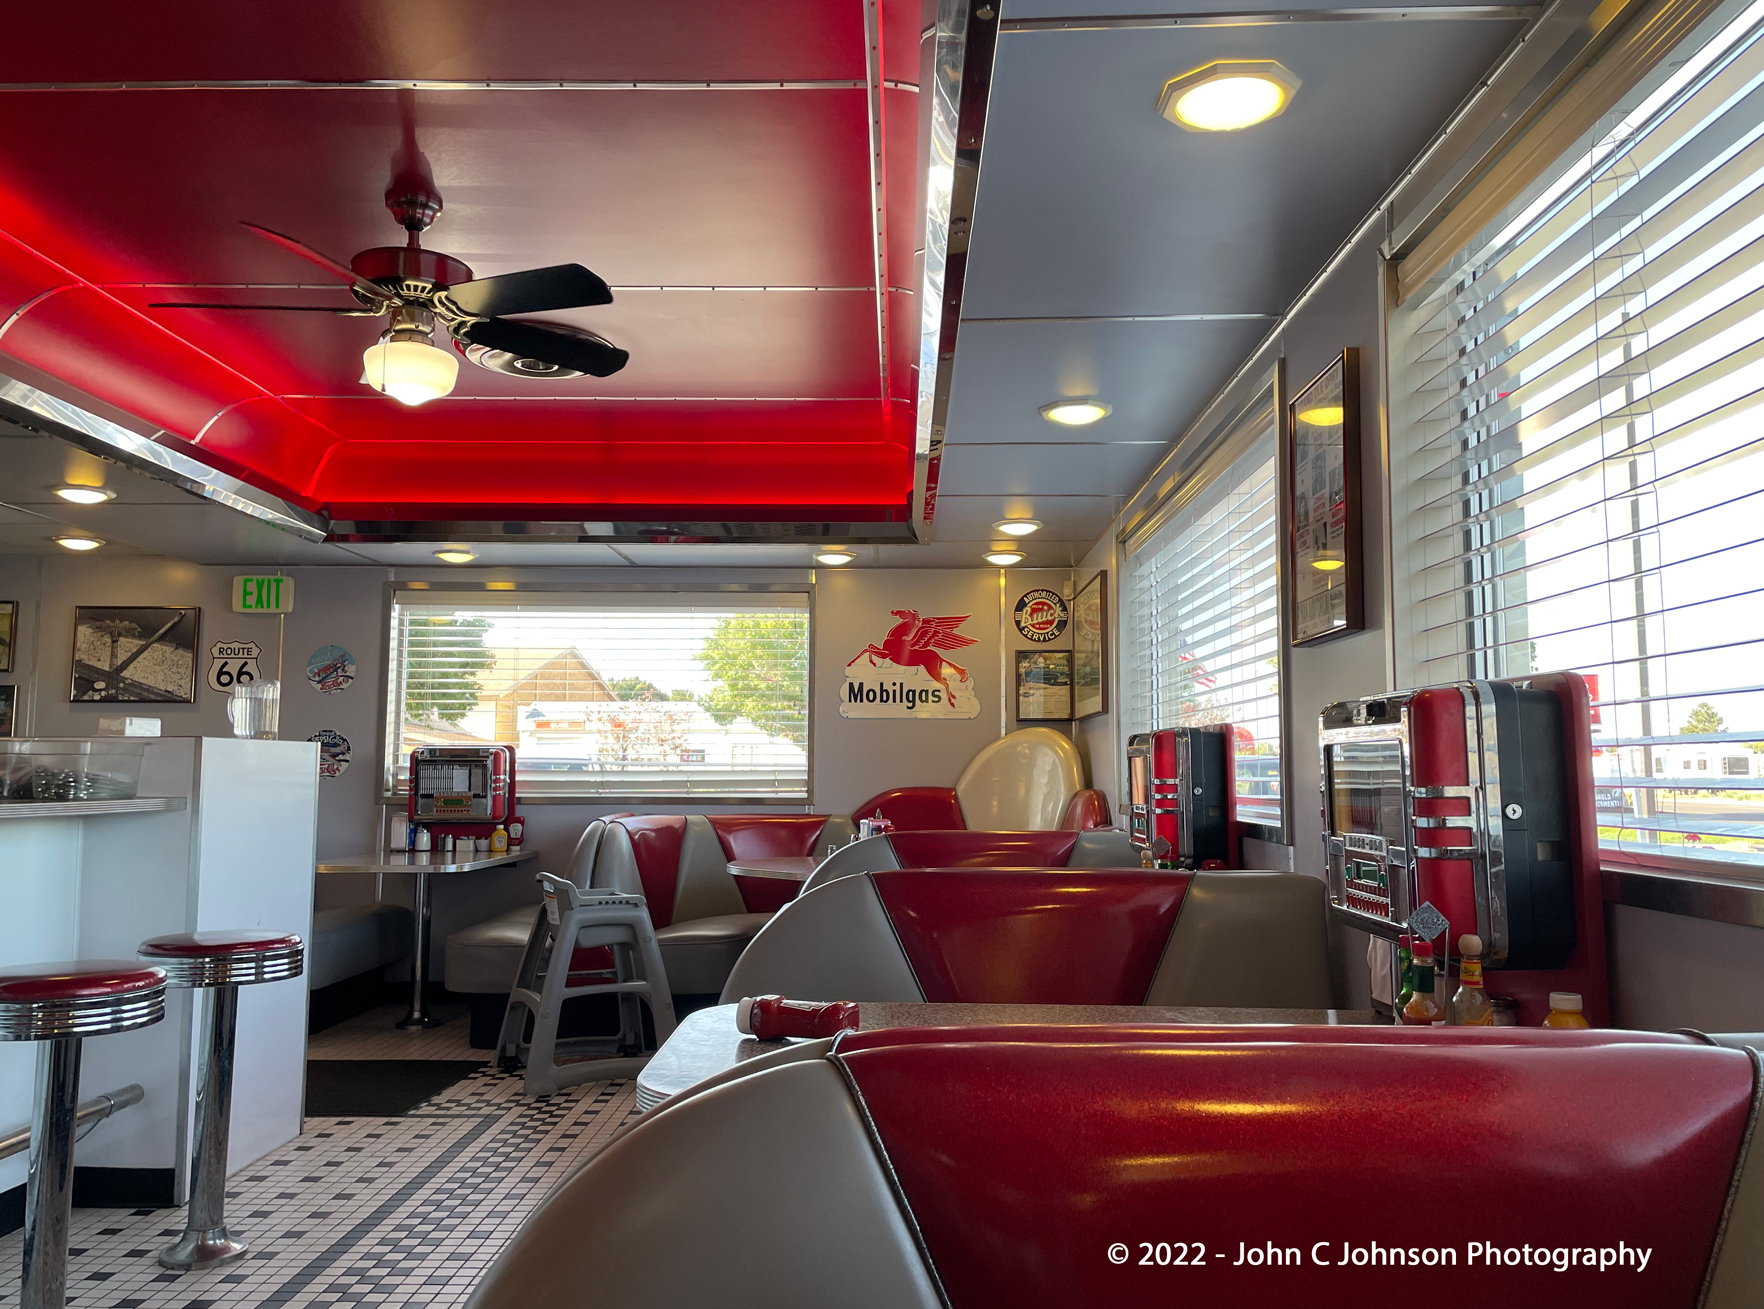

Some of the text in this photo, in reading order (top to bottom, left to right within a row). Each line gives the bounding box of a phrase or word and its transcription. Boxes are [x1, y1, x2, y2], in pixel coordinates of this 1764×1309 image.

[242, 578, 284, 609] EXIT
[1023, 590, 1060, 604] AUTHORIZED
[1020, 602, 1064, 628] Buick
[1022, 627, 1061, 641] SERVICE
[218, 647, 253, 656] ROUTE
[216, 660, 254, 687] 66
[848, 681, 942, 710] Mobilgas
